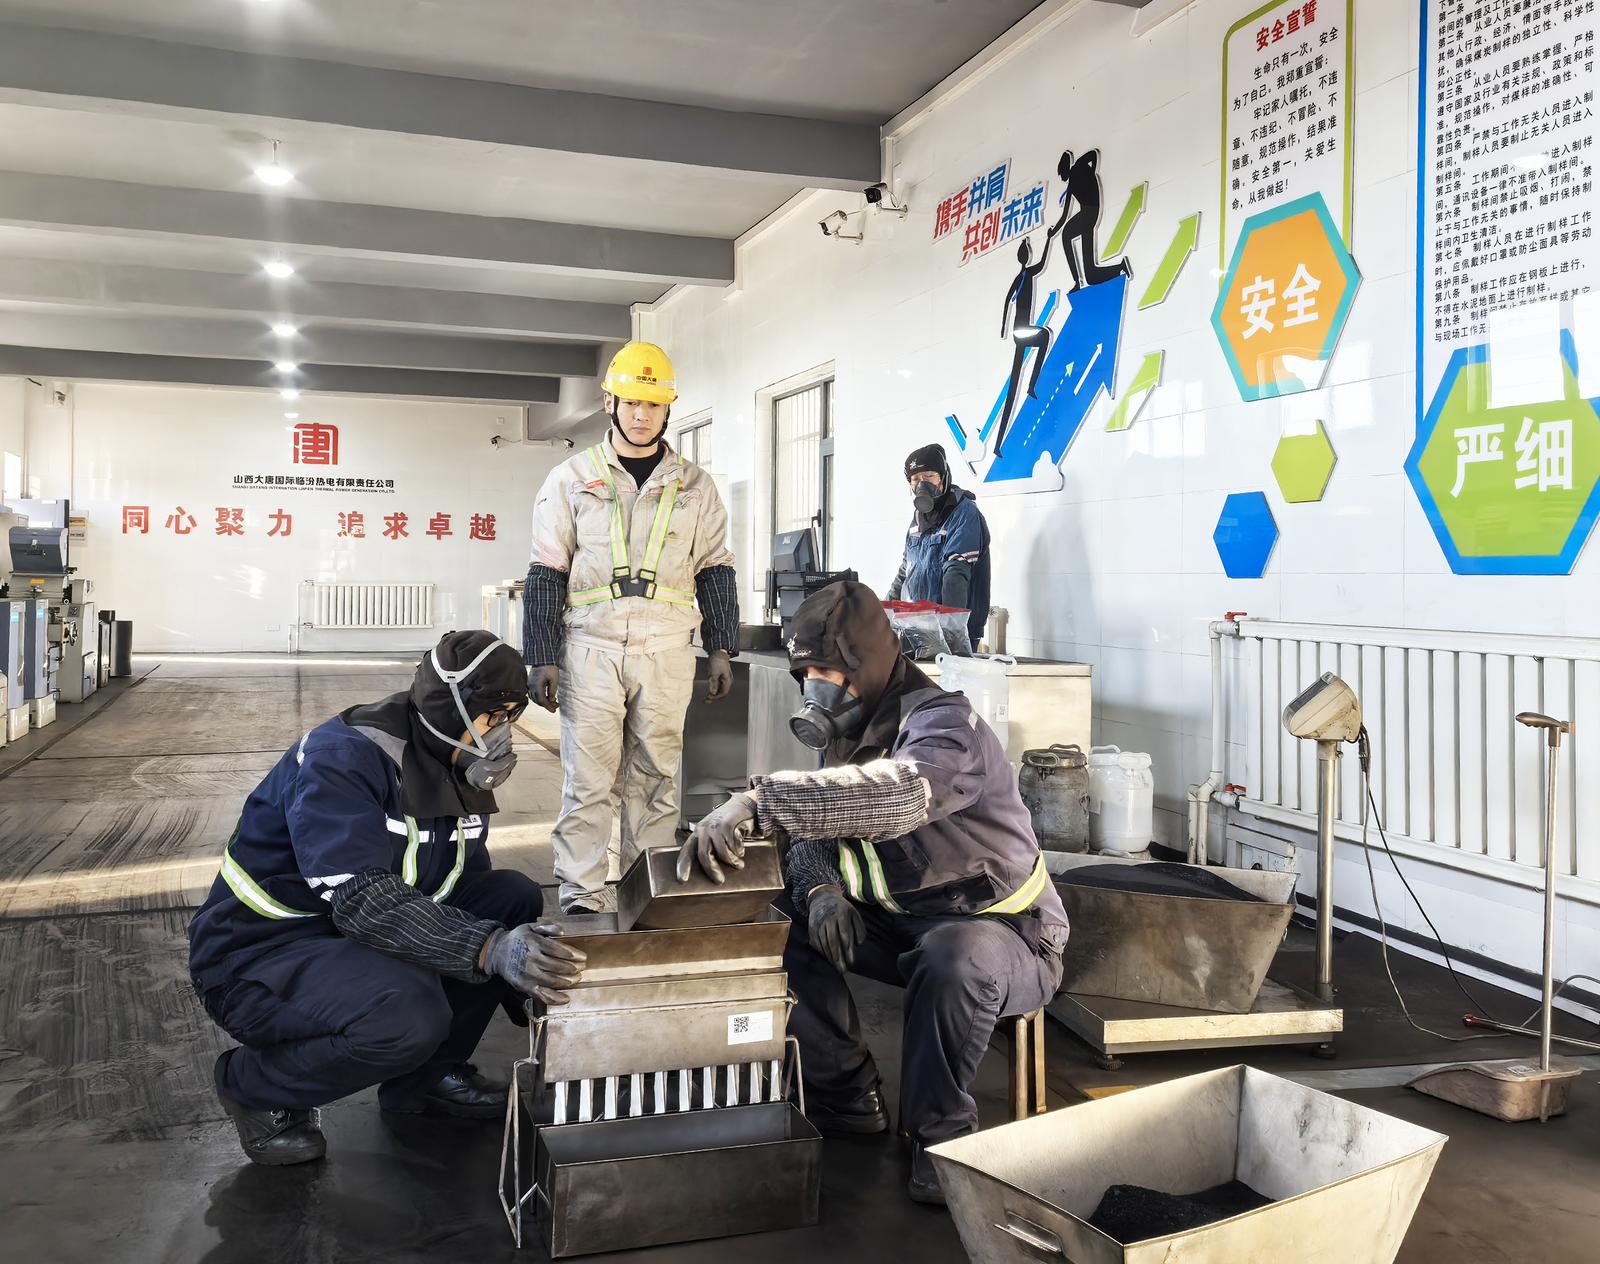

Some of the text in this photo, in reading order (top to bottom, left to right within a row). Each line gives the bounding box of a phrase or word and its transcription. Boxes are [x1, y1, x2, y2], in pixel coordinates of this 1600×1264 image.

[1256, 0, 1316, 51] 安全宣誓
[1438, 1, 1464, 23] 第一条
[1438, 28, 1463, 49] 第二条
[1437, 83, 1462, 104] 第三条
[1436, 89, 1593, 157] 第四条 严禁与工作无关人员进入制
[933, 164, 1007, 239] 携手并肩
[1435, 179, 1461, 197] 第五条
[962, 187, 1043, 261] 共创未来
[1435, 206, 1460, 223] 第六条
[1435, 209, 1591, 263] 第七条 制样人员在进行制样工作
[1240, 263, 1322, 341] 安全
[1434, 287, 1460, 303] 第八条
[1434, 314, 1460, 329] 第九条
[1450, 416, 1574, 498] 严细
[233, 475, 394, 488] 山西大唐国际临汾热电有限责任公司
[122, 505, 497, 541] 同心聚力 追求卓越
